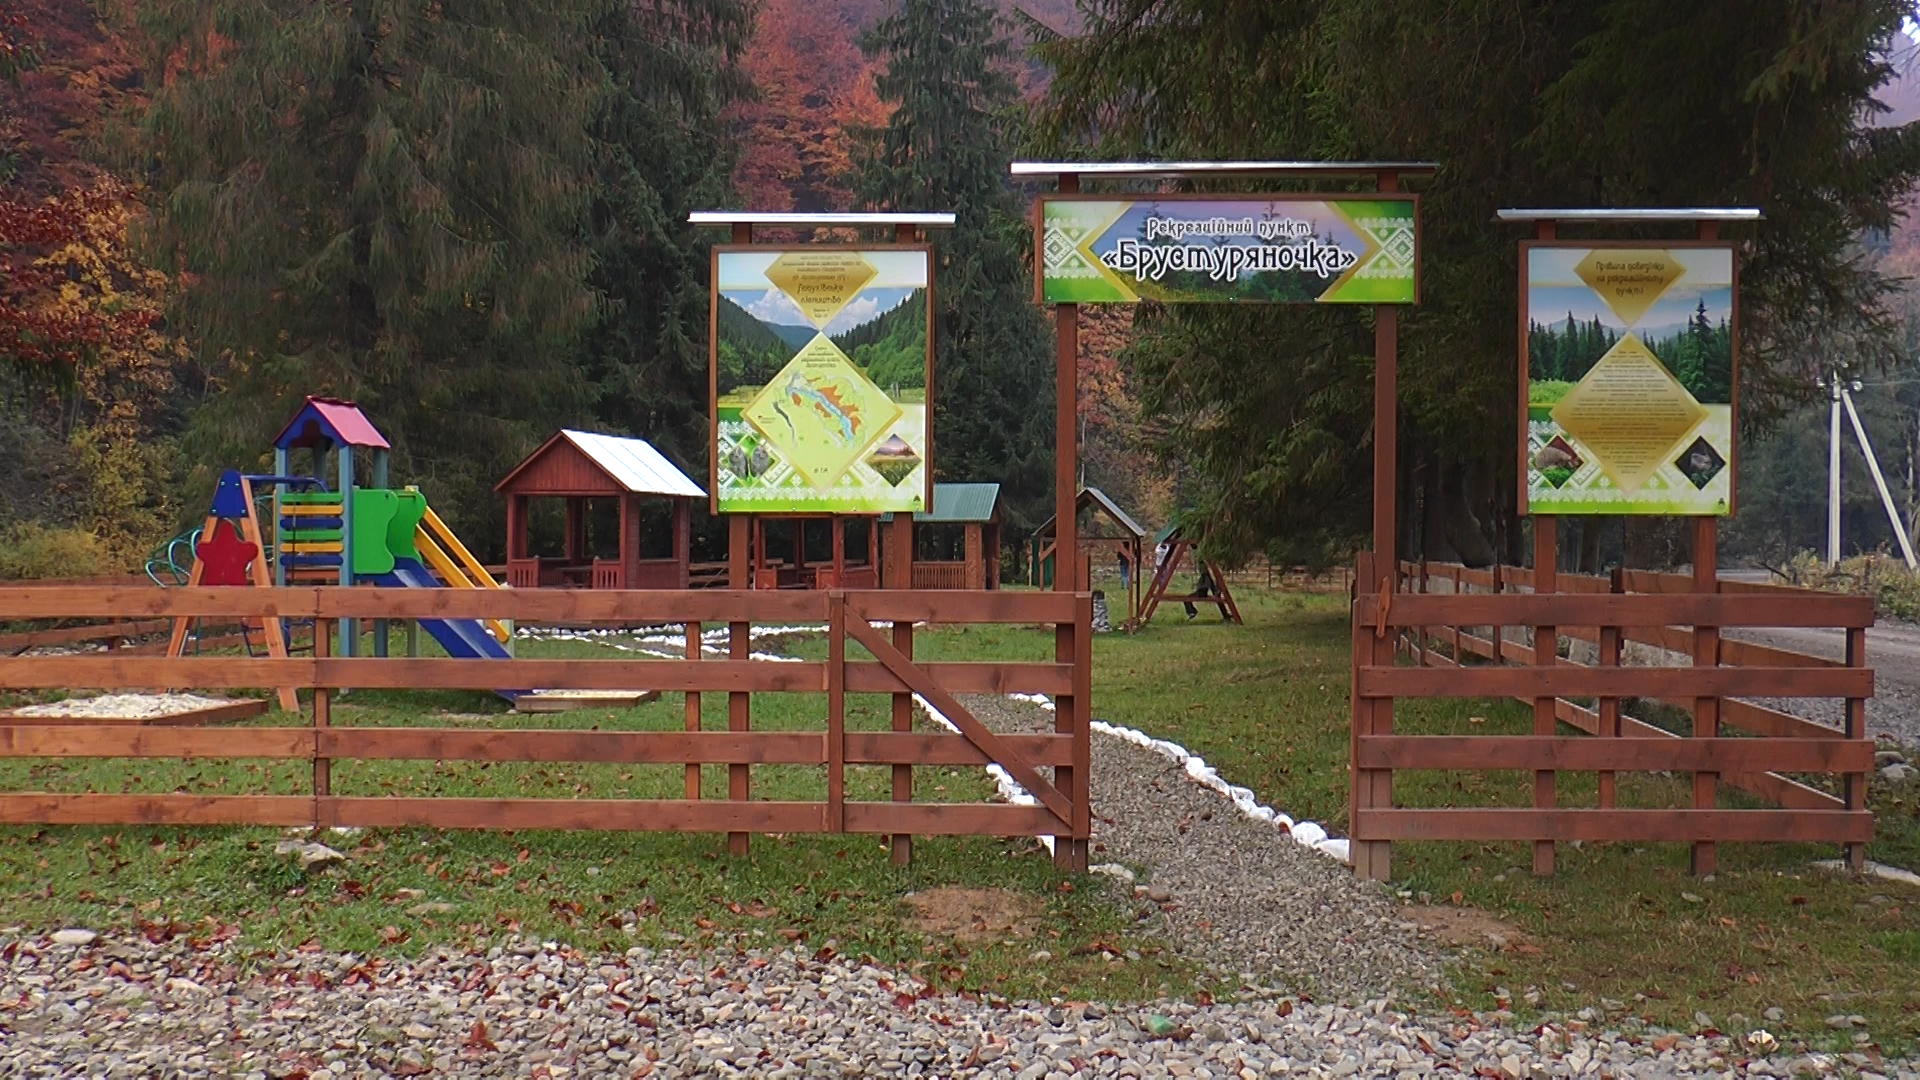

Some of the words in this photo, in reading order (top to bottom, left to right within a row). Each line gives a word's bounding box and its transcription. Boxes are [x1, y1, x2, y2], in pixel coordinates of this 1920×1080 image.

[1148, 218, 1252, 239] Рекреаційний
[1259, 219, 1311, 239] пункт
[1102, 240, 1358, 280] «Брустуряночка»
